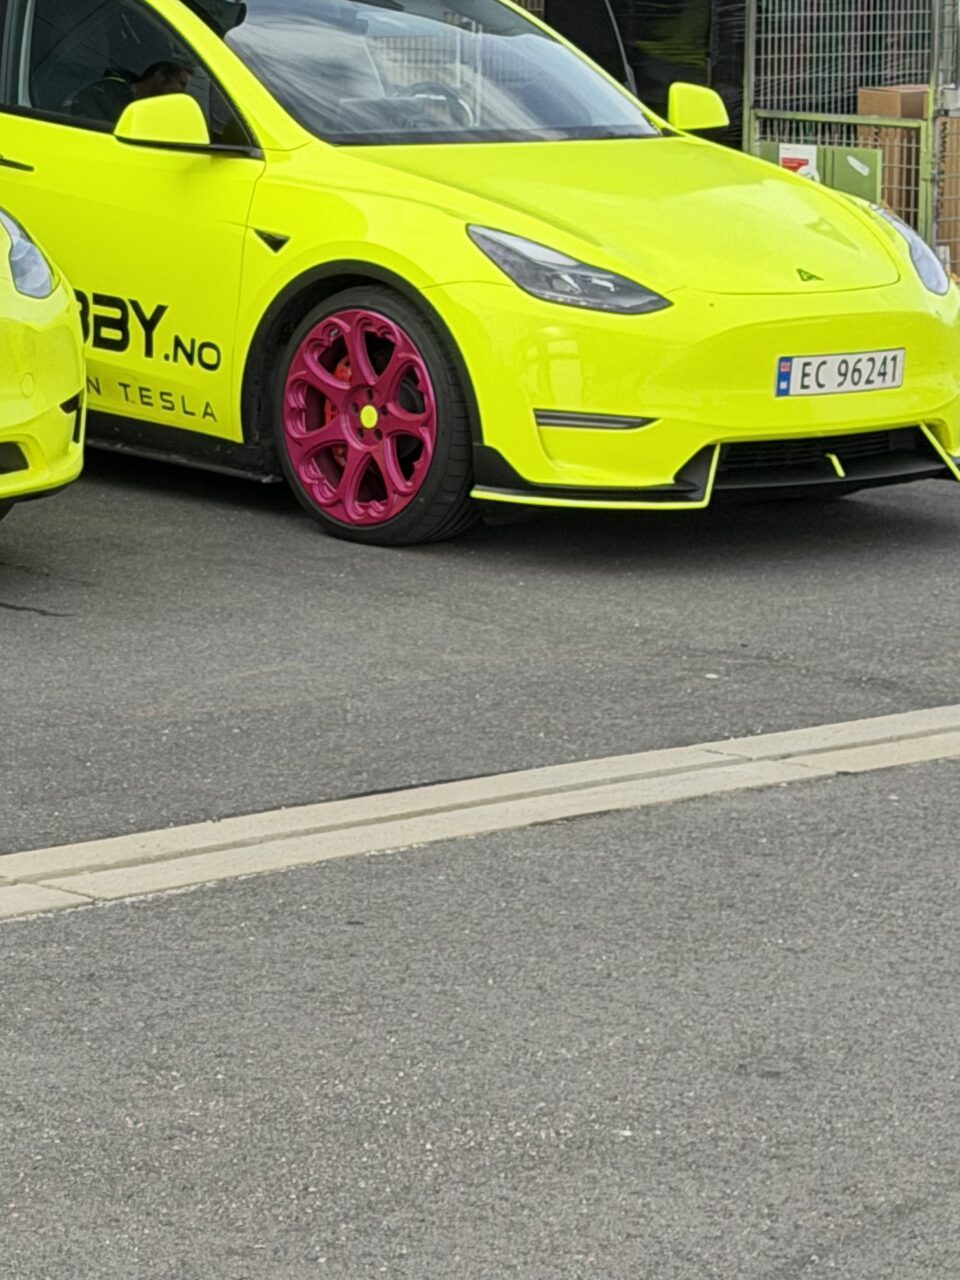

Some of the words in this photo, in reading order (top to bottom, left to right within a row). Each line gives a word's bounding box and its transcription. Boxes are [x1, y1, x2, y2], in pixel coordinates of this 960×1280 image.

[800, 360, 828, 390] EC
[837, 354, 898, 389] 96241
[118, 382, 217, 422] TESLA
